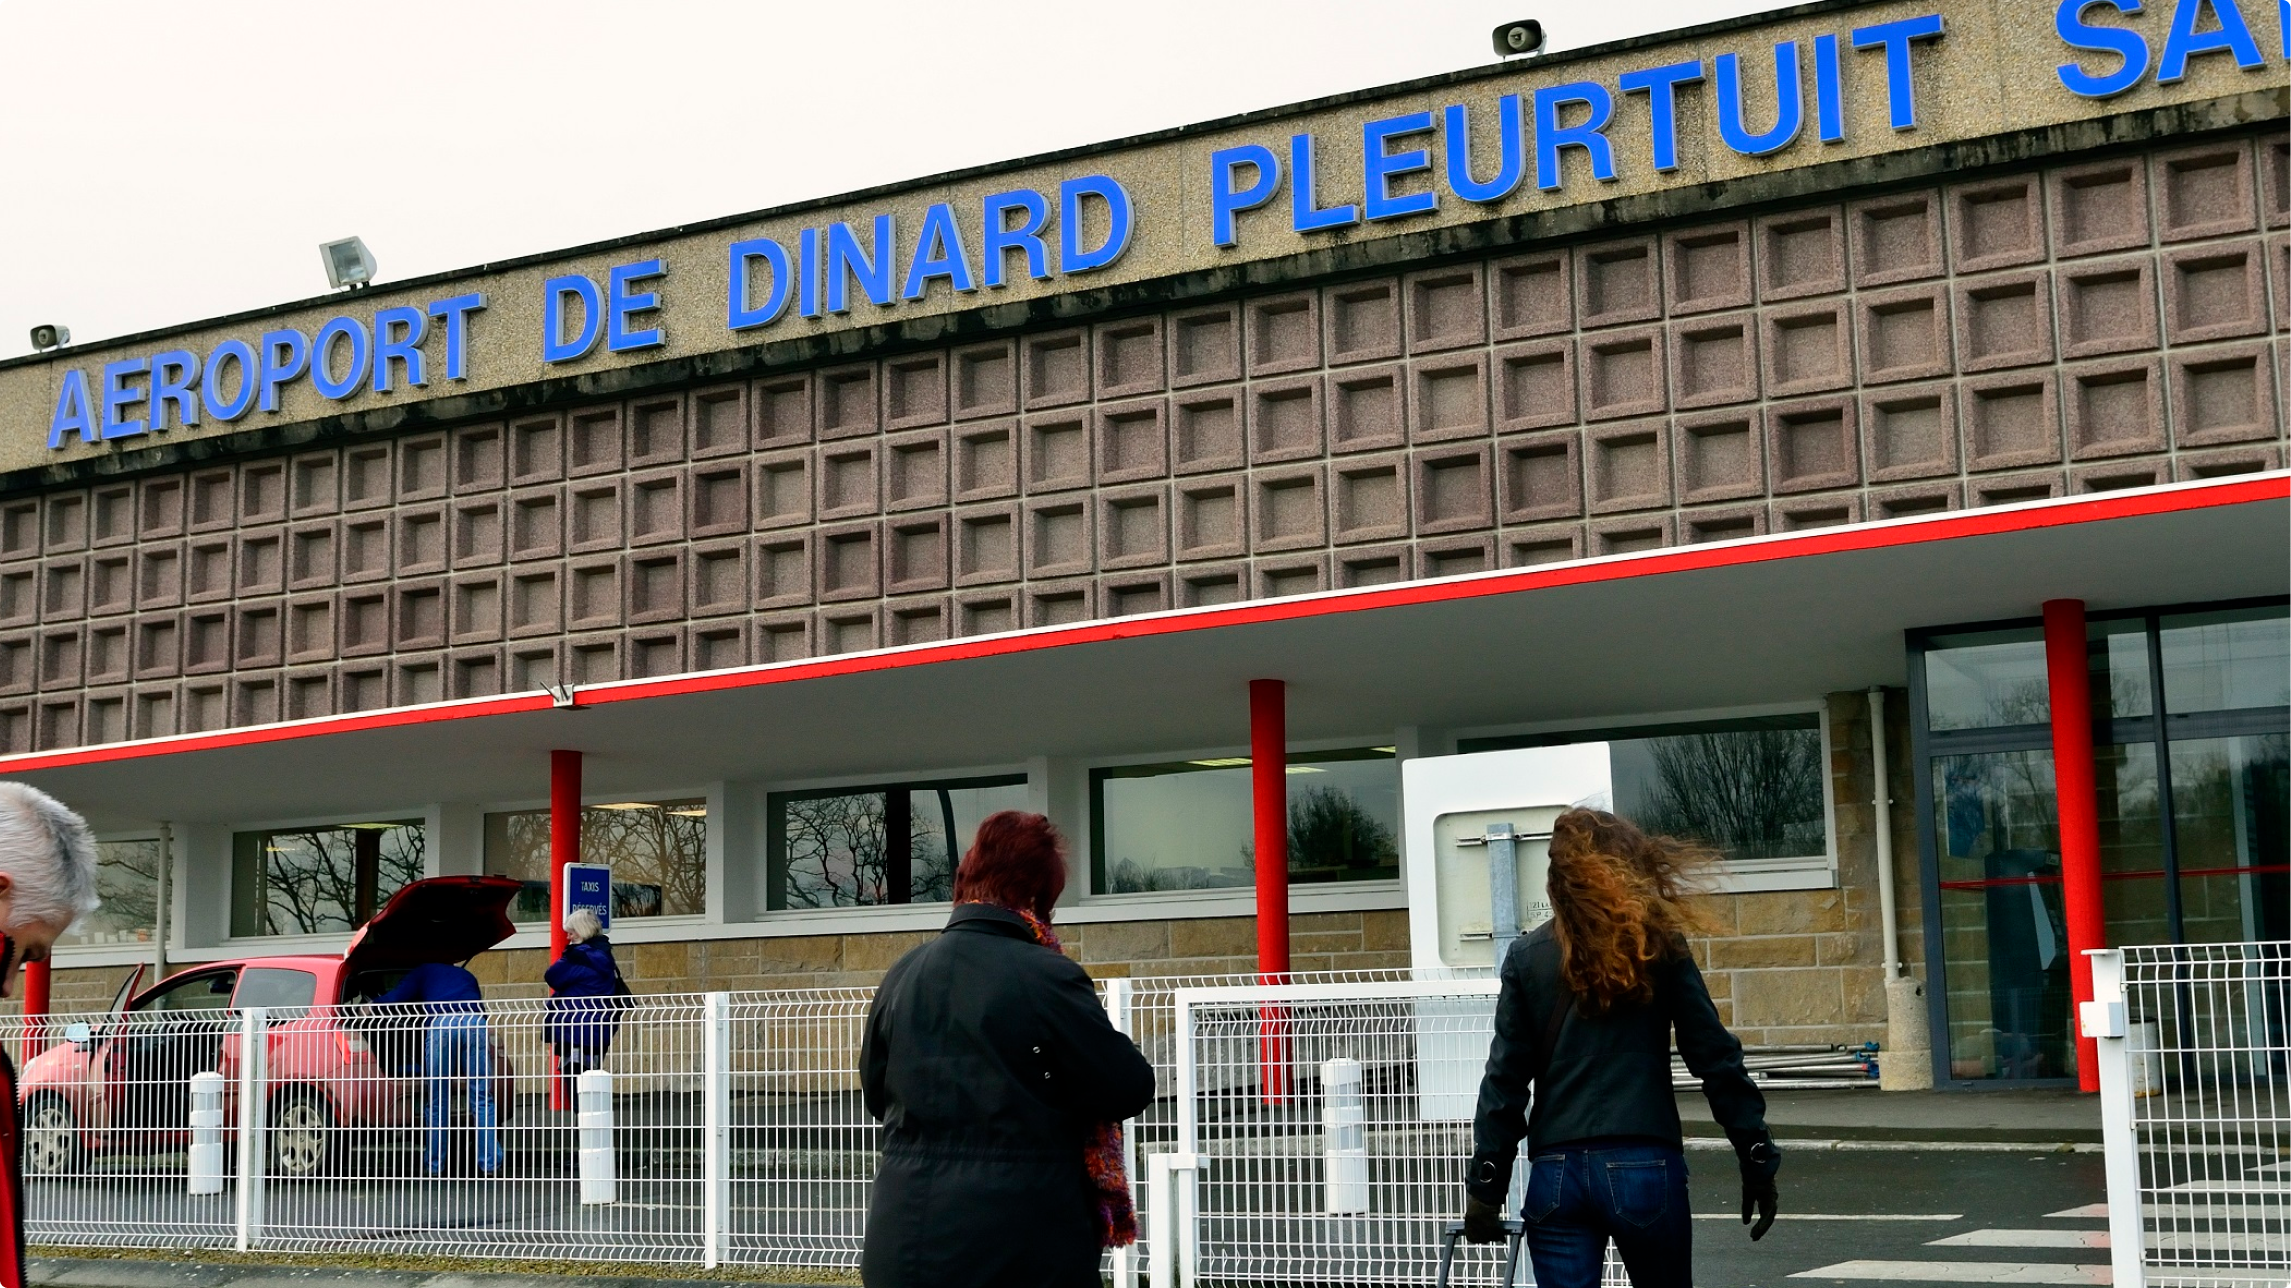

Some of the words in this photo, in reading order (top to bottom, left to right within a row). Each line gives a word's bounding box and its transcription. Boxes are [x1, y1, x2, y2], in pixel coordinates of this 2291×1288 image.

[47, 292, 488, 450] AEROPORT
[543, 258, 668, 363] DE
[728, 175, 1135, 331] DINARD
[1211, 13, 1945, 247] PLEURTUIT
[581, 881, 600, 893] TAXIS
